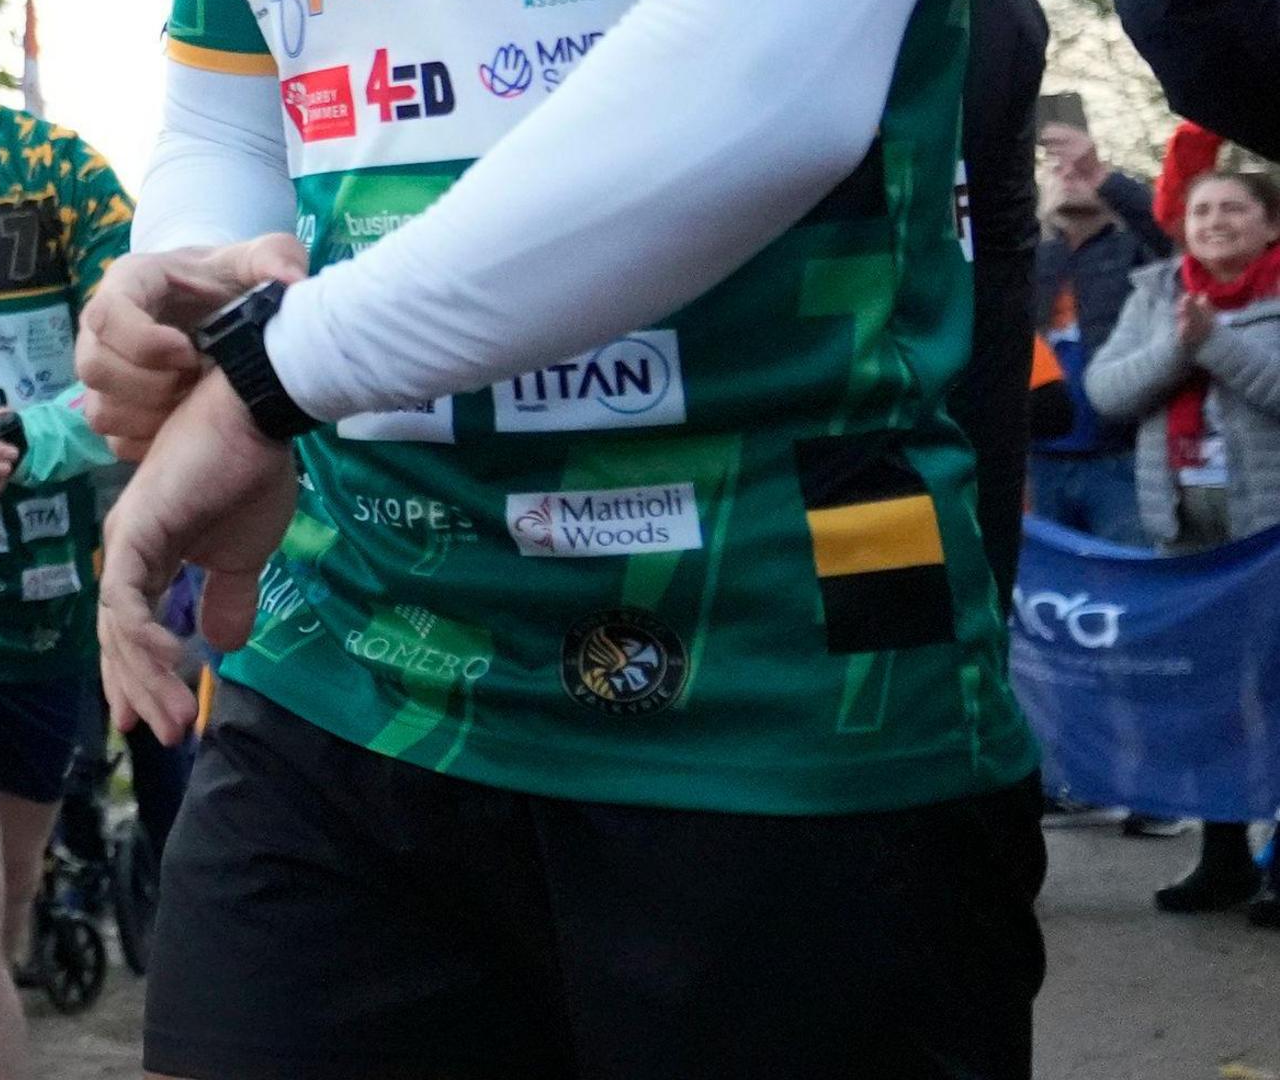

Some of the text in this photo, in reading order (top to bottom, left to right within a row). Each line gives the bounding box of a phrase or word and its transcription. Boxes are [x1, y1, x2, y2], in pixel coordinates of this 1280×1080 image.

[366, 48, 456, 123] 4ED
[559, 489, 682, 522] Mattioli
[561, 522, 670, 549] Woods
